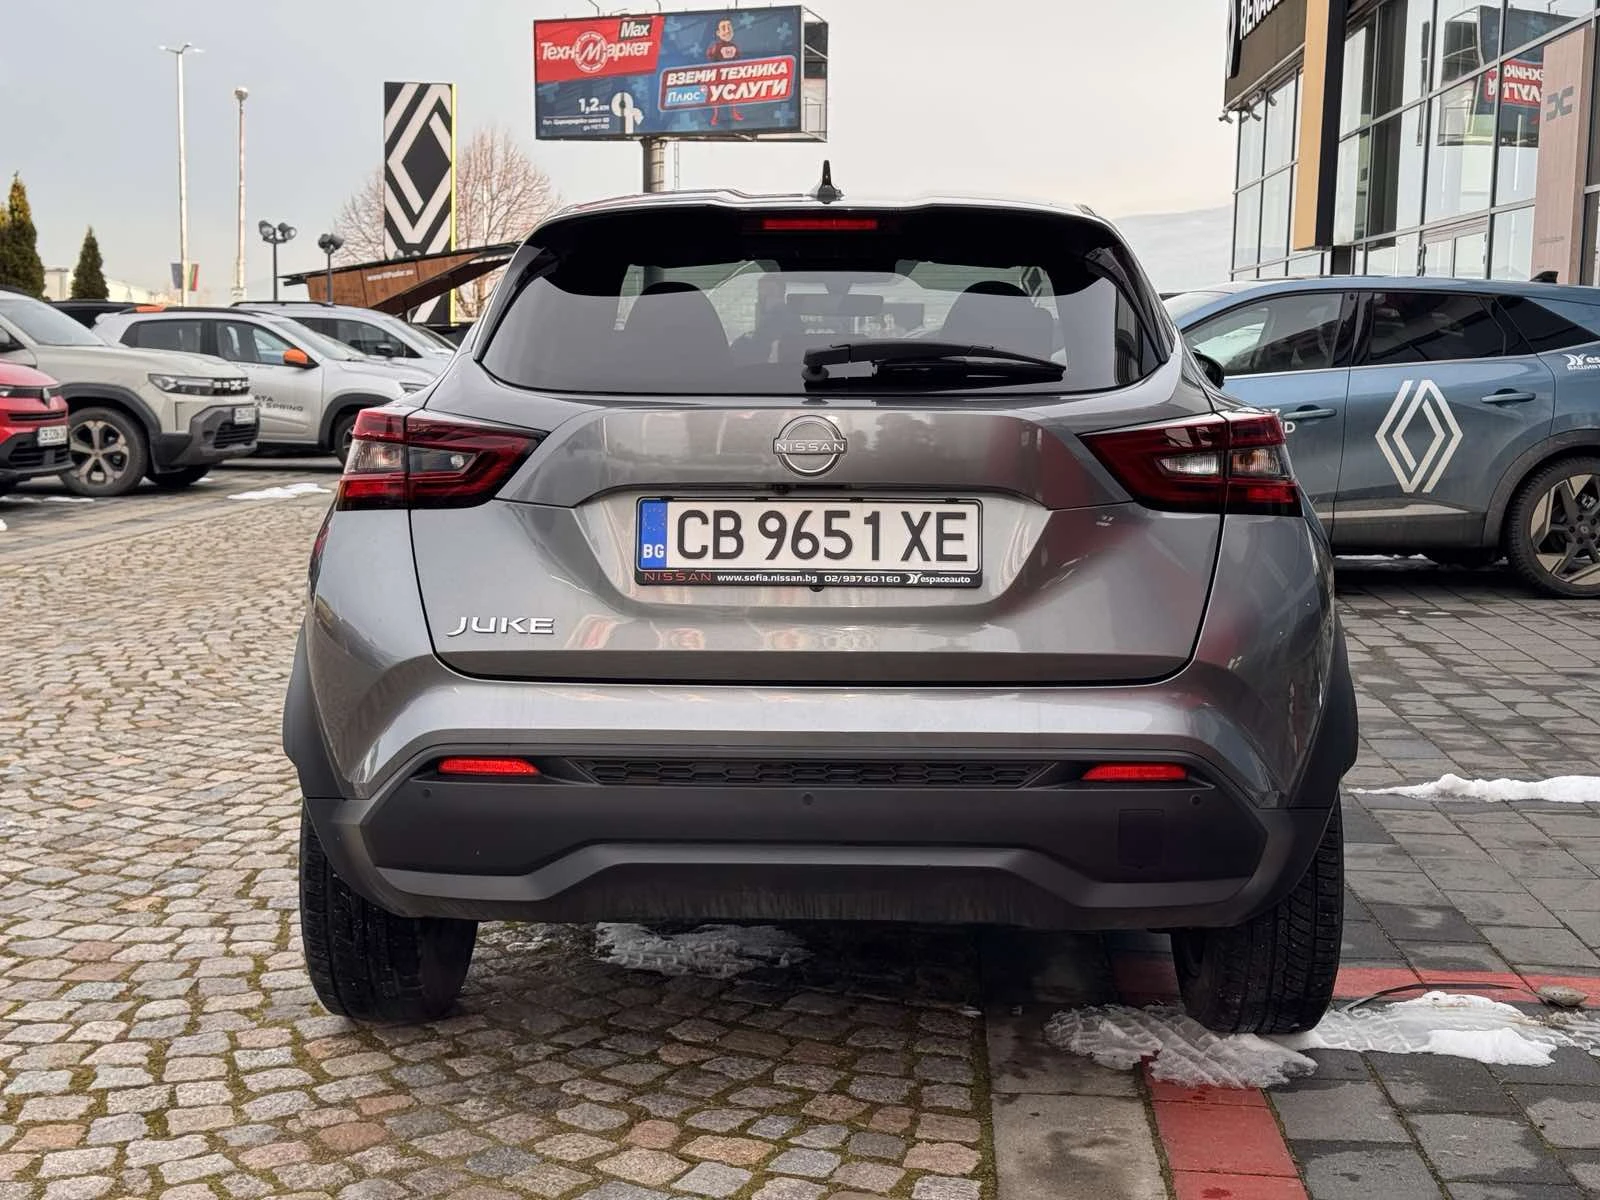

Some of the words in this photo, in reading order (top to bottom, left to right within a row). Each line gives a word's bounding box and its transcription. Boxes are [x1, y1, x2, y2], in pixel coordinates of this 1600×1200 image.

[620, 21, 651, 38] Max
[666, 68, 717, 86] ВЗЕМИ
[720, 61, 788, 82] ТЕХНИКА
[710, 79, 788, 103] УСЛУГИ
[578, 97, 599, 114] 1,2
[776, 442, 845, 452] NISSAN
[677, 509, 744, 561] CB
[758, 509, 880, 562] 9651
[900, 510, 968, 562] XE
[643, 544, 665, 559] BG
[644, 572, 712, 582] NISSAN
[717, 573, 818, 584] www.sofia.nissan.bg
[920, 574, 971, 584] espaceauto
[446, 616, 555, 638] JUKE
